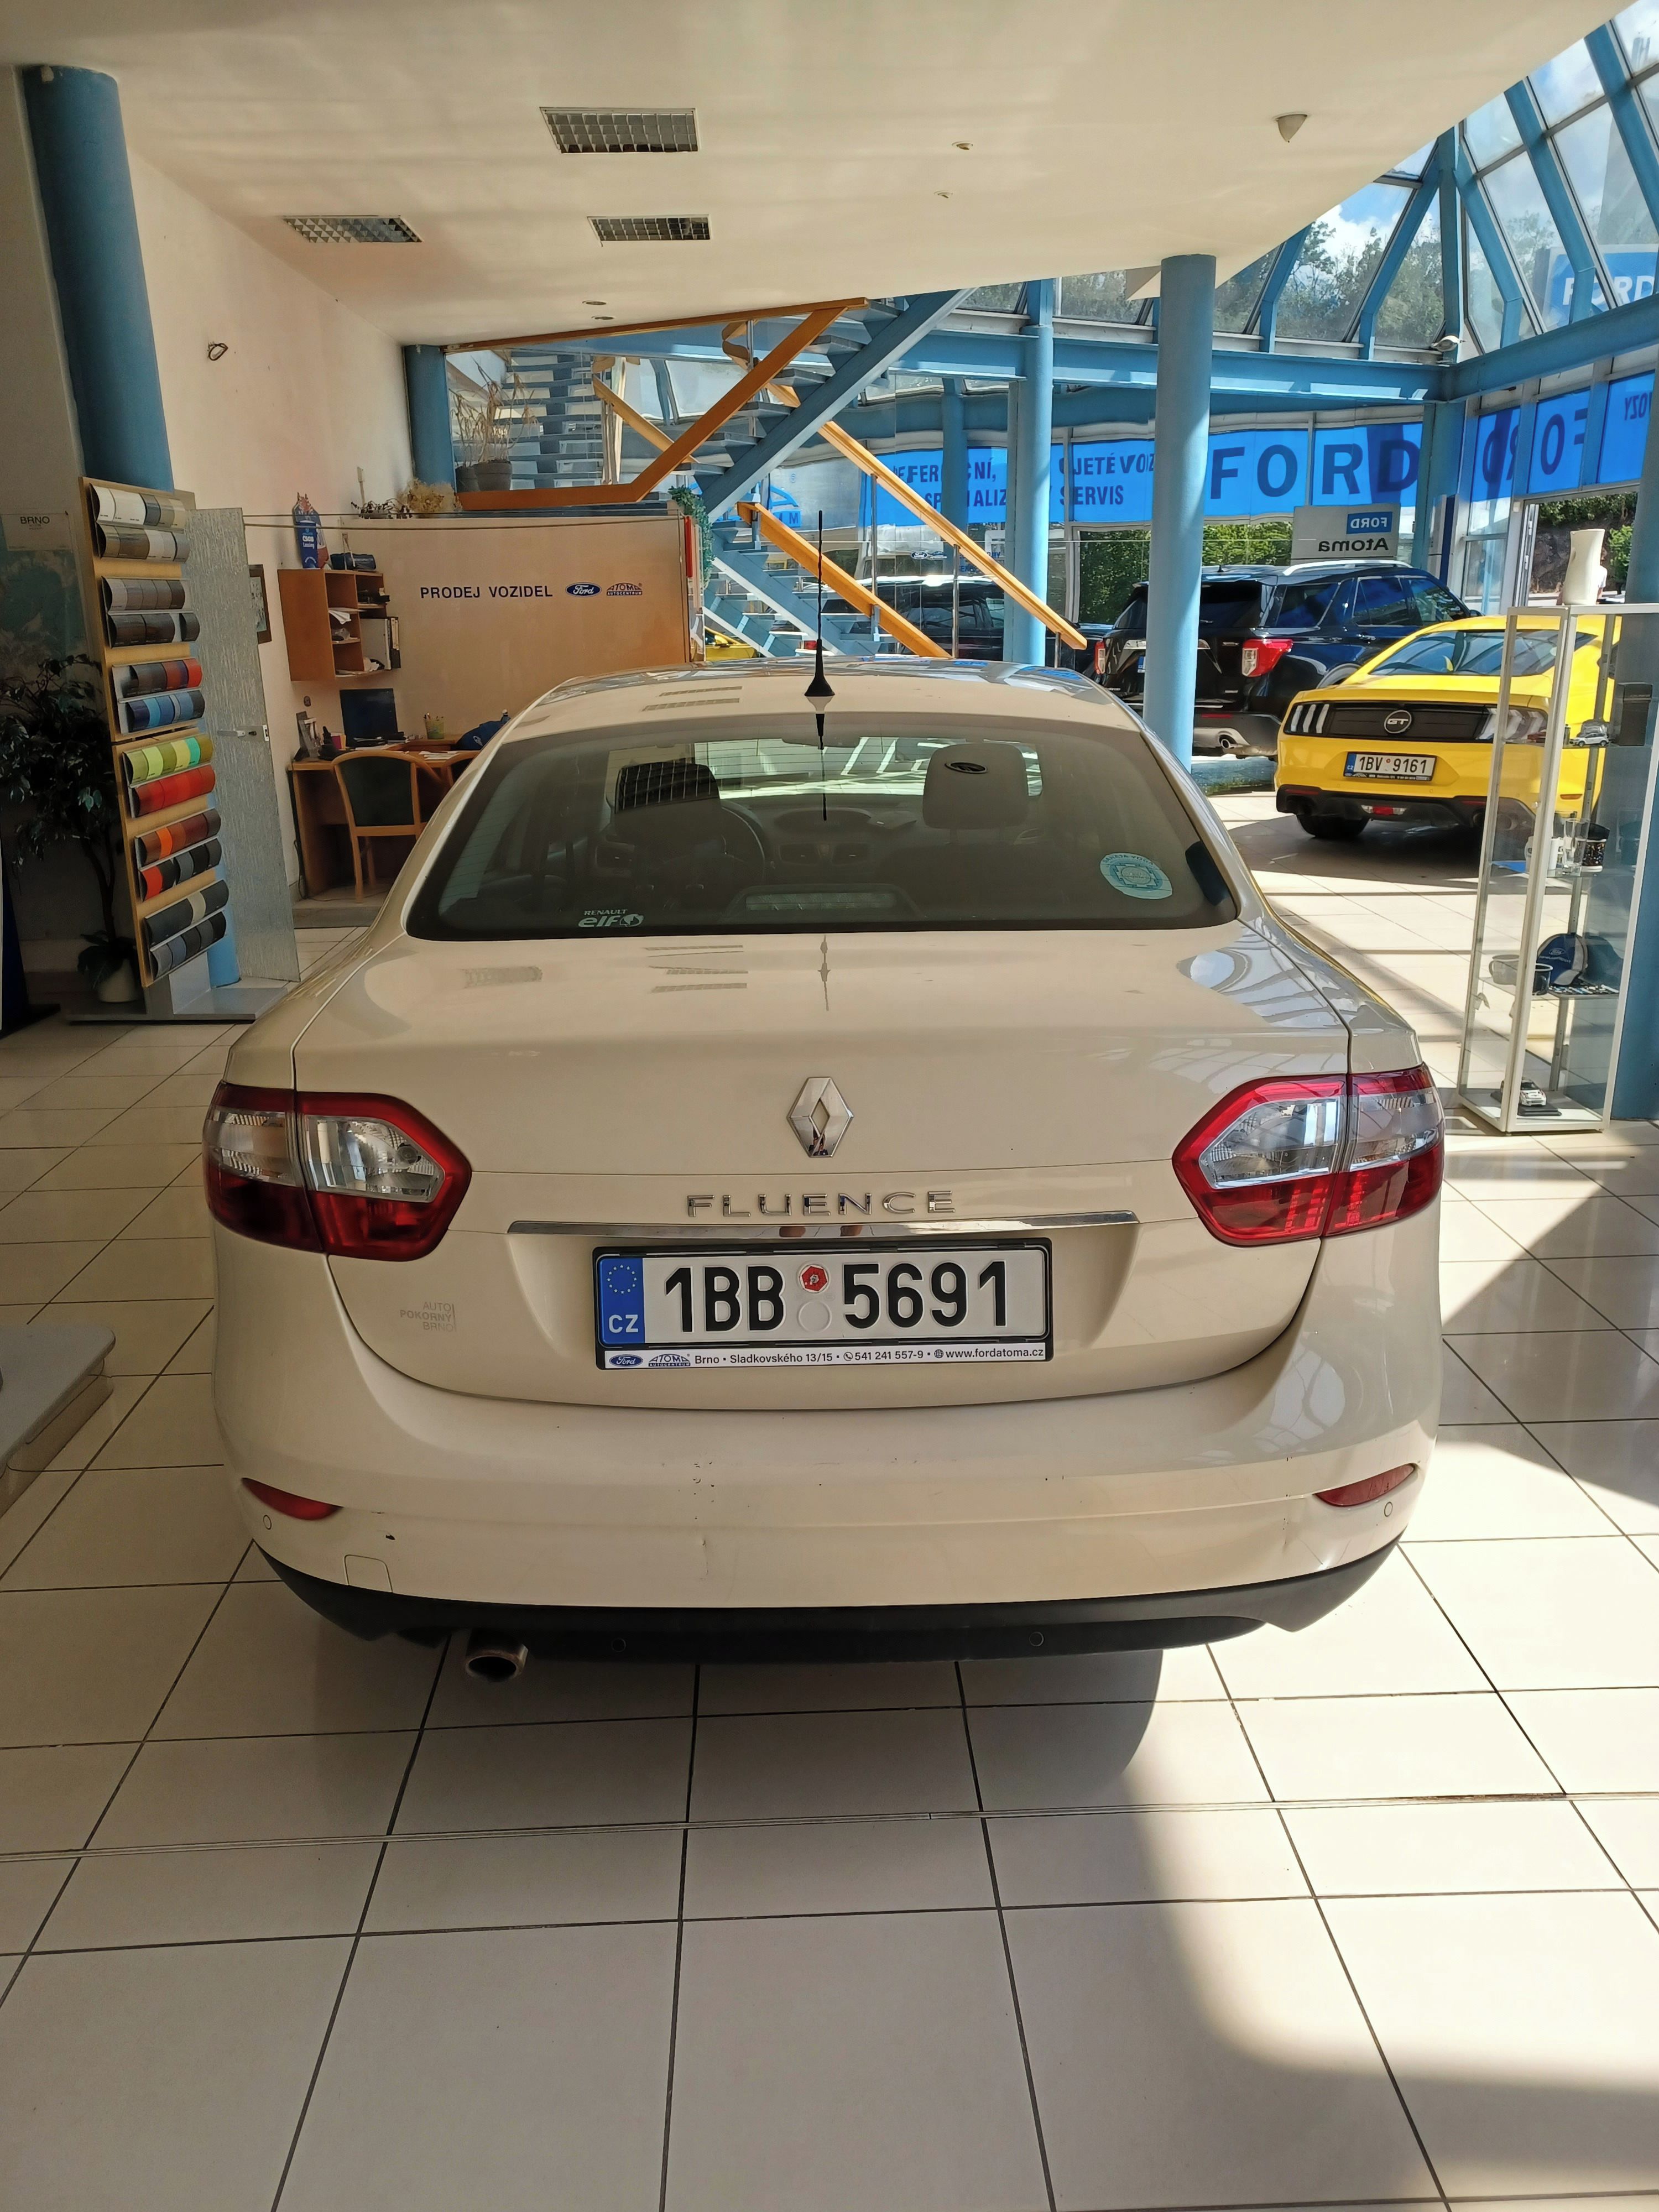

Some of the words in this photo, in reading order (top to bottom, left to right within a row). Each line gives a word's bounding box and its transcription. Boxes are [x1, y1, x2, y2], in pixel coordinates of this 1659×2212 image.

[1210, 440, 1421, 499] FORD
[20, 516, 50, 524] BRNO
[420, 586, 480, 599] PRODEJ
[489, 585, 552, 598] VOZIDEL
[572, 584, 594, 595] Ford
[1359, 756, 1384, 771] 1BV
[1392, 758, 1427, 774] 9161
[578, 915, 620, 927] elf
[686, 1190, 956, 1218] FLUENCE
[664, 1266, 785, 1333] 1BB
[844, 1260, 1007, 1329] 5691
[422, 1301, 452, 1312] AUTO
[399, 1308, 452, 1322] POKORNÝ
[423, 1321, 454, 1332] BRNO
[608, 1314, 639, 1334] CZ
[615, 1356, 637, 1365] Ford
[695, 1355, 719, 1364] Brno
[730, 1353, 803, 1363] Sladkovského
[805, 1352, 833, 1363] 13/15
[854, 1352, 872, 1361] 541
[875, 1352, 892, 1360] 241
[895, 1350, 924, 1359] 557-9
[946, 1347, 1044, 1358] www.fordatoma.cz
